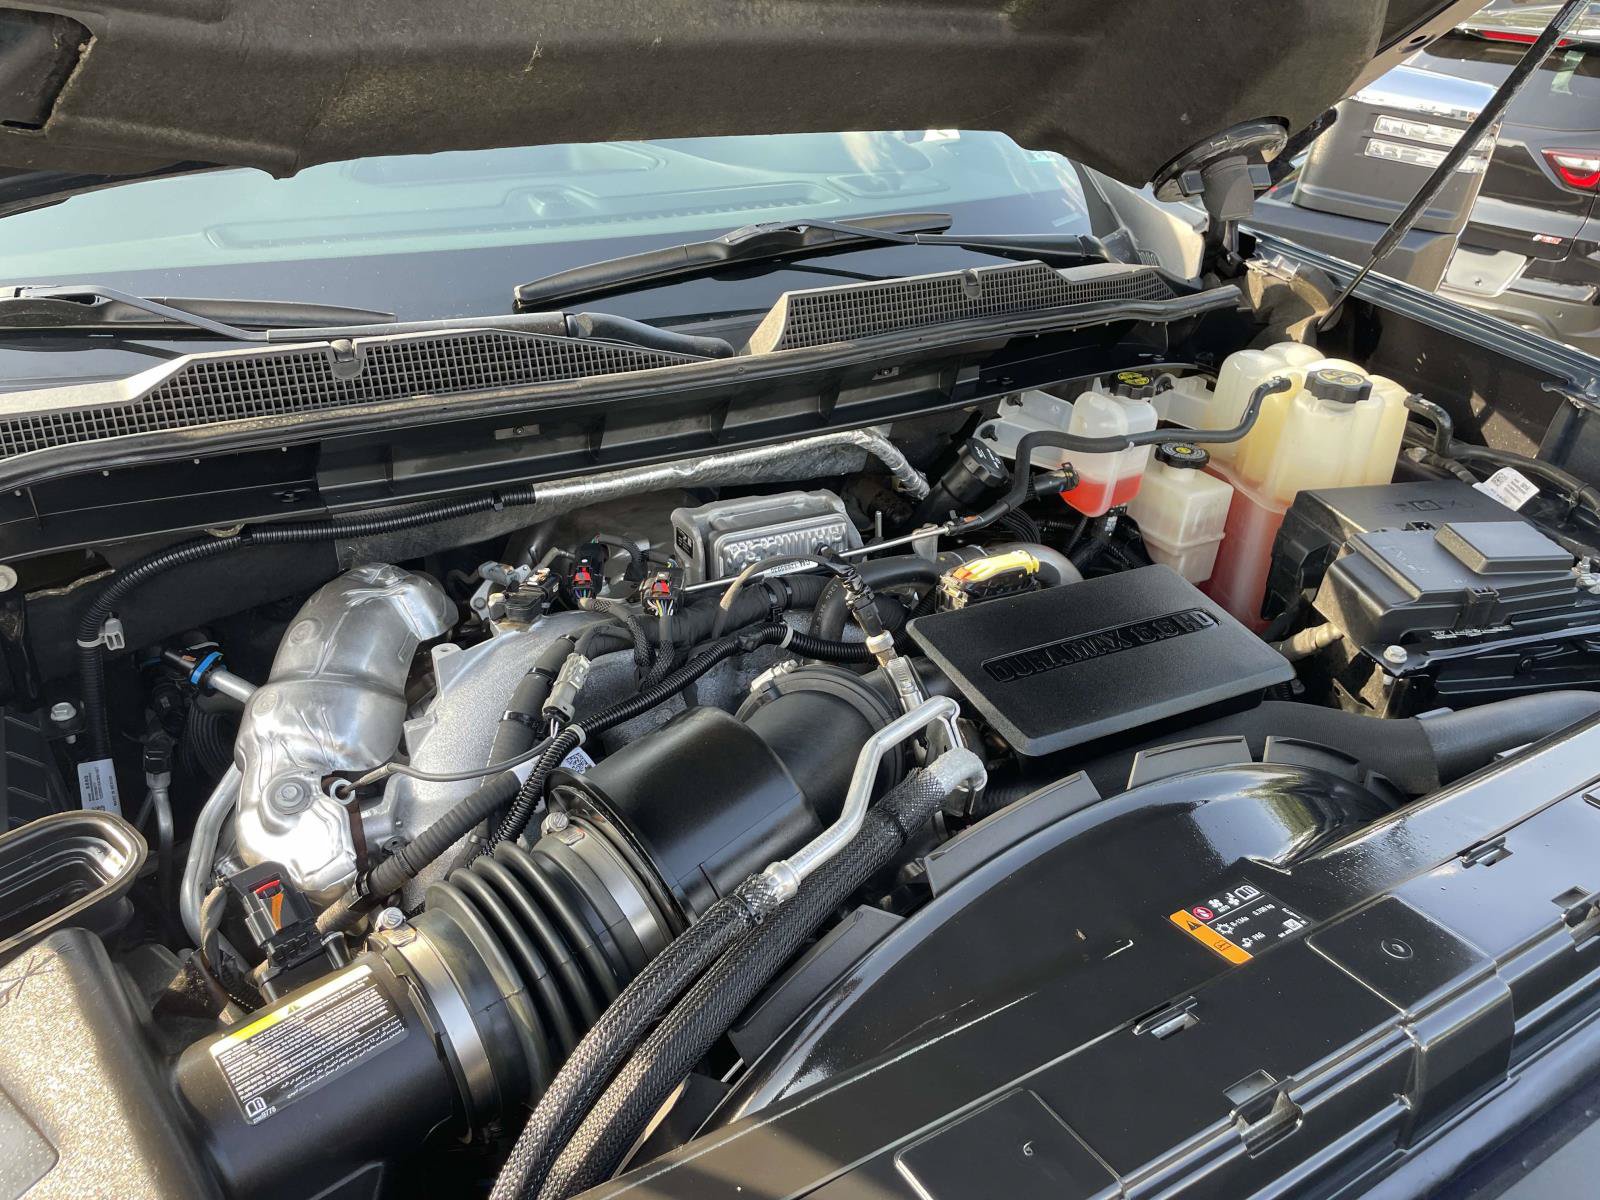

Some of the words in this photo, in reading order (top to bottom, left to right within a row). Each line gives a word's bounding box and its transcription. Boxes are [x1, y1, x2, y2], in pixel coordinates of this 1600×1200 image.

[985, 630, 1133, 682] DURAMAX
[1131, 618, 1179, 644] 6.6
[1172, 609, 1216, 633] HD
